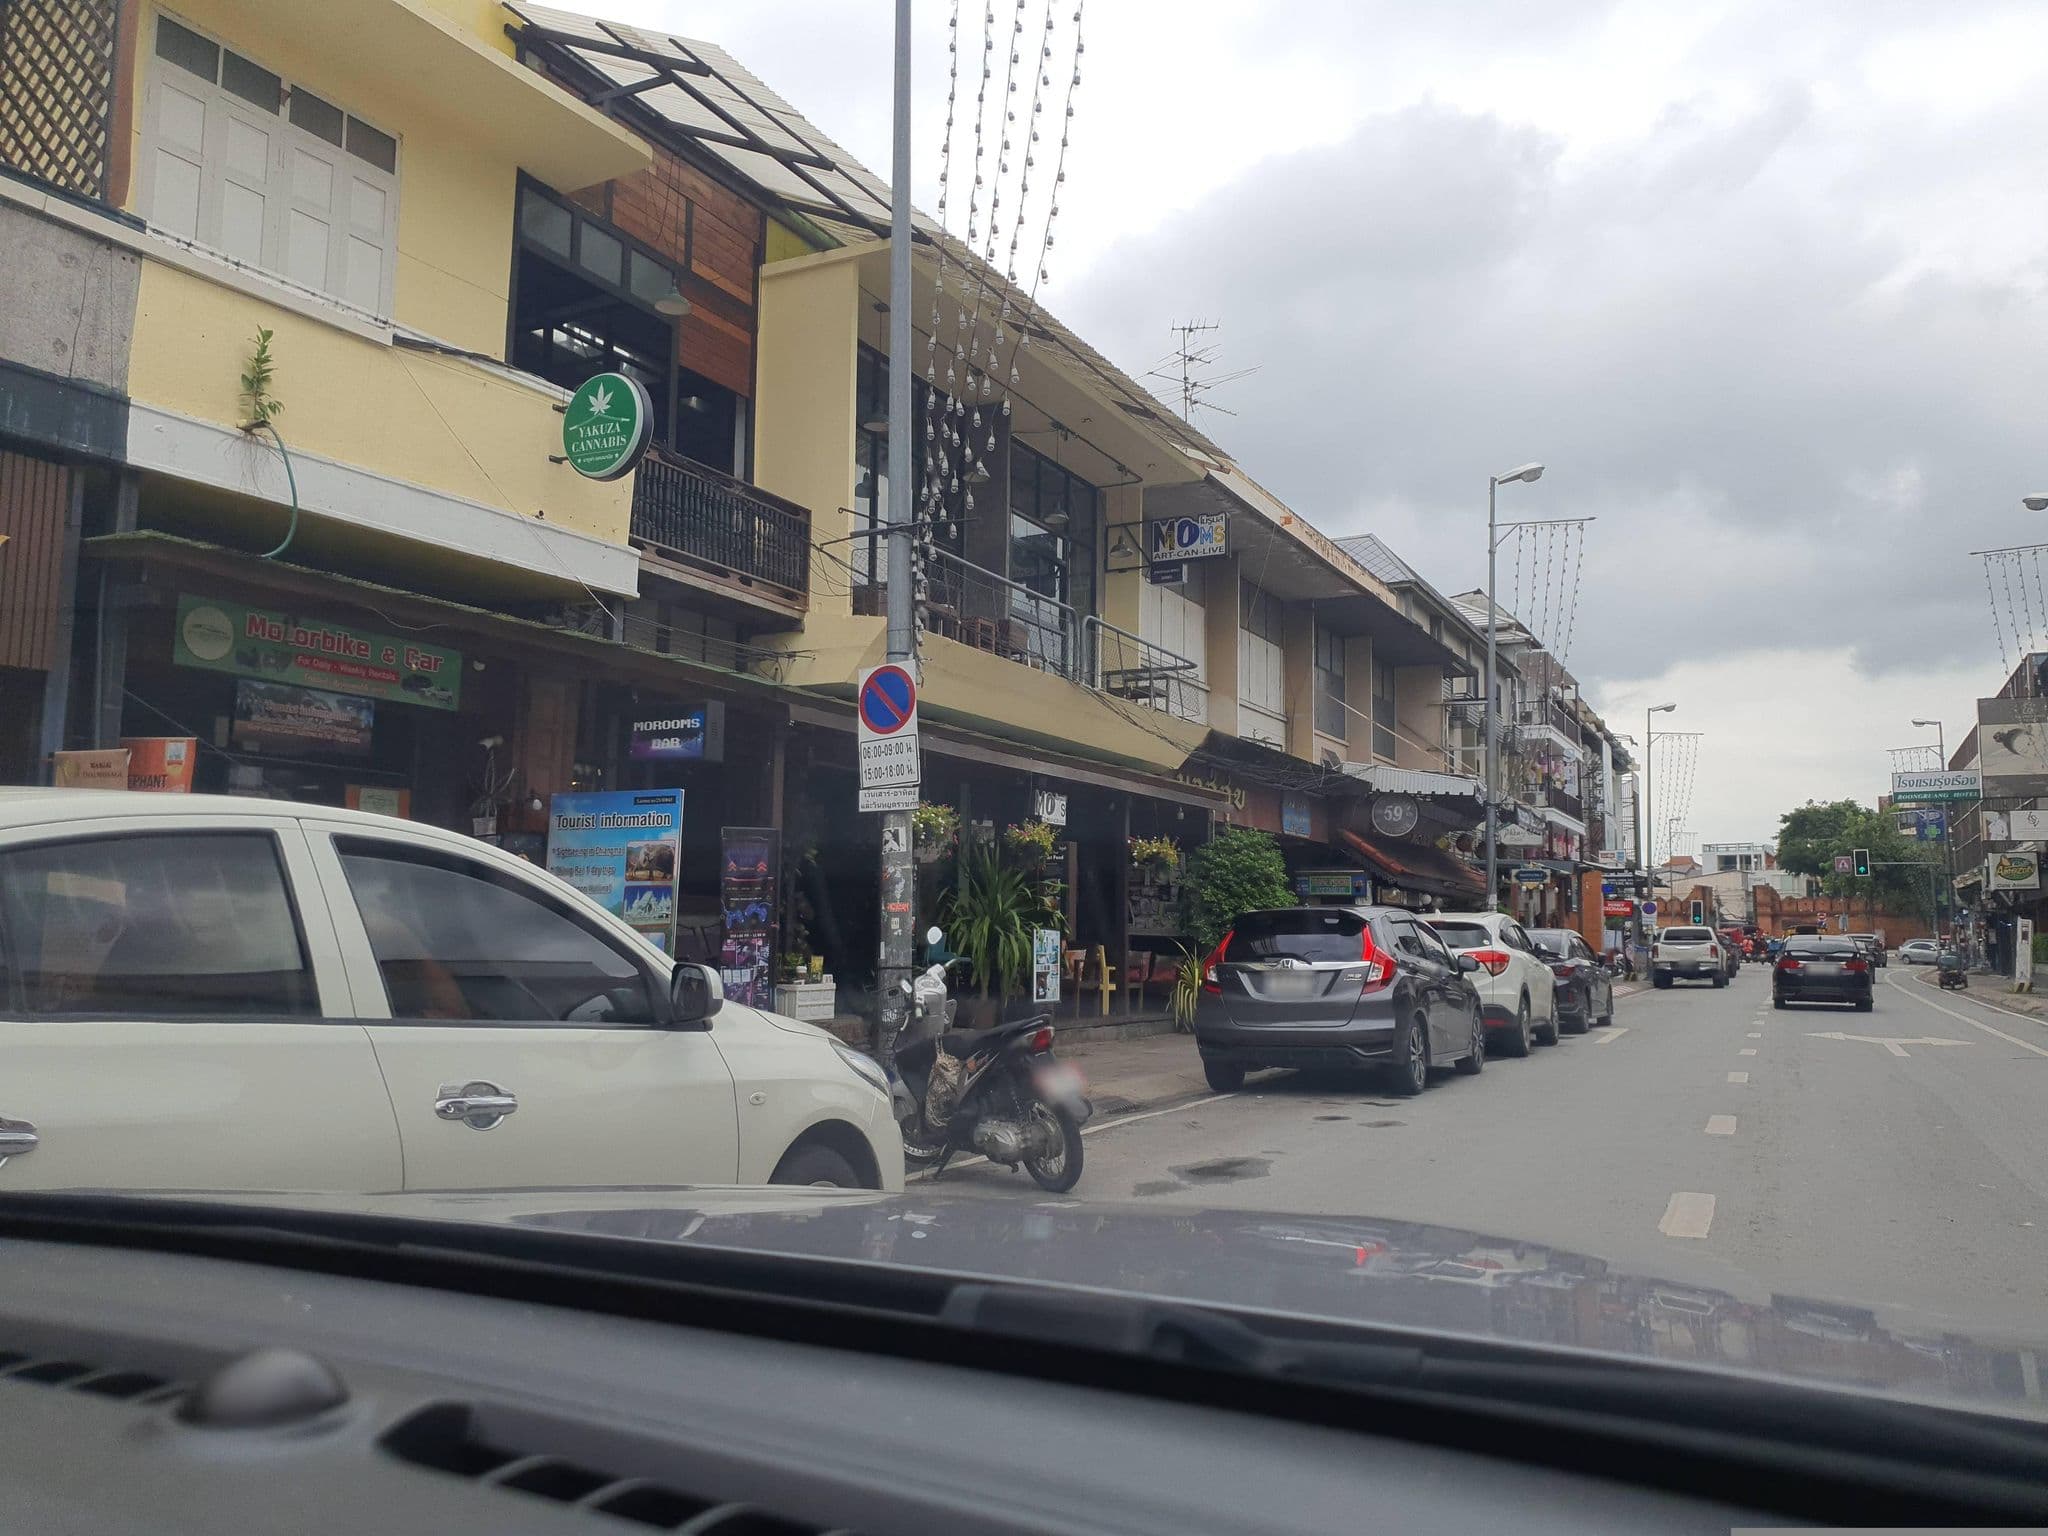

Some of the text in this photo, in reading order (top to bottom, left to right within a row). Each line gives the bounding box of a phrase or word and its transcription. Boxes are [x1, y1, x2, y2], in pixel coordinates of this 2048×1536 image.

[579, 422, 620, 438] YAKUZA
[572, 435, 627, 452] CANNABIS
[1153, 545, 1225, 560] ART-CAN-LIVE
[245, 612, 371, 658] Moorbike
[381, 646, 396, 665] &
[403, 646, 444, 673] Car
[633, 718, 701, 731] MOROOMS
[651, 737, 680, 750] BAR
[863, 742, 904, 760] 06:00-09:00
[864, 763, 905, 781] 15:00-18:00
[1897, 774, 1977, 790] โรงแรมรุ่งเรือง
[556, 811, 672, 829] Tourist information
[1383, 804, 1403, 821] 59
